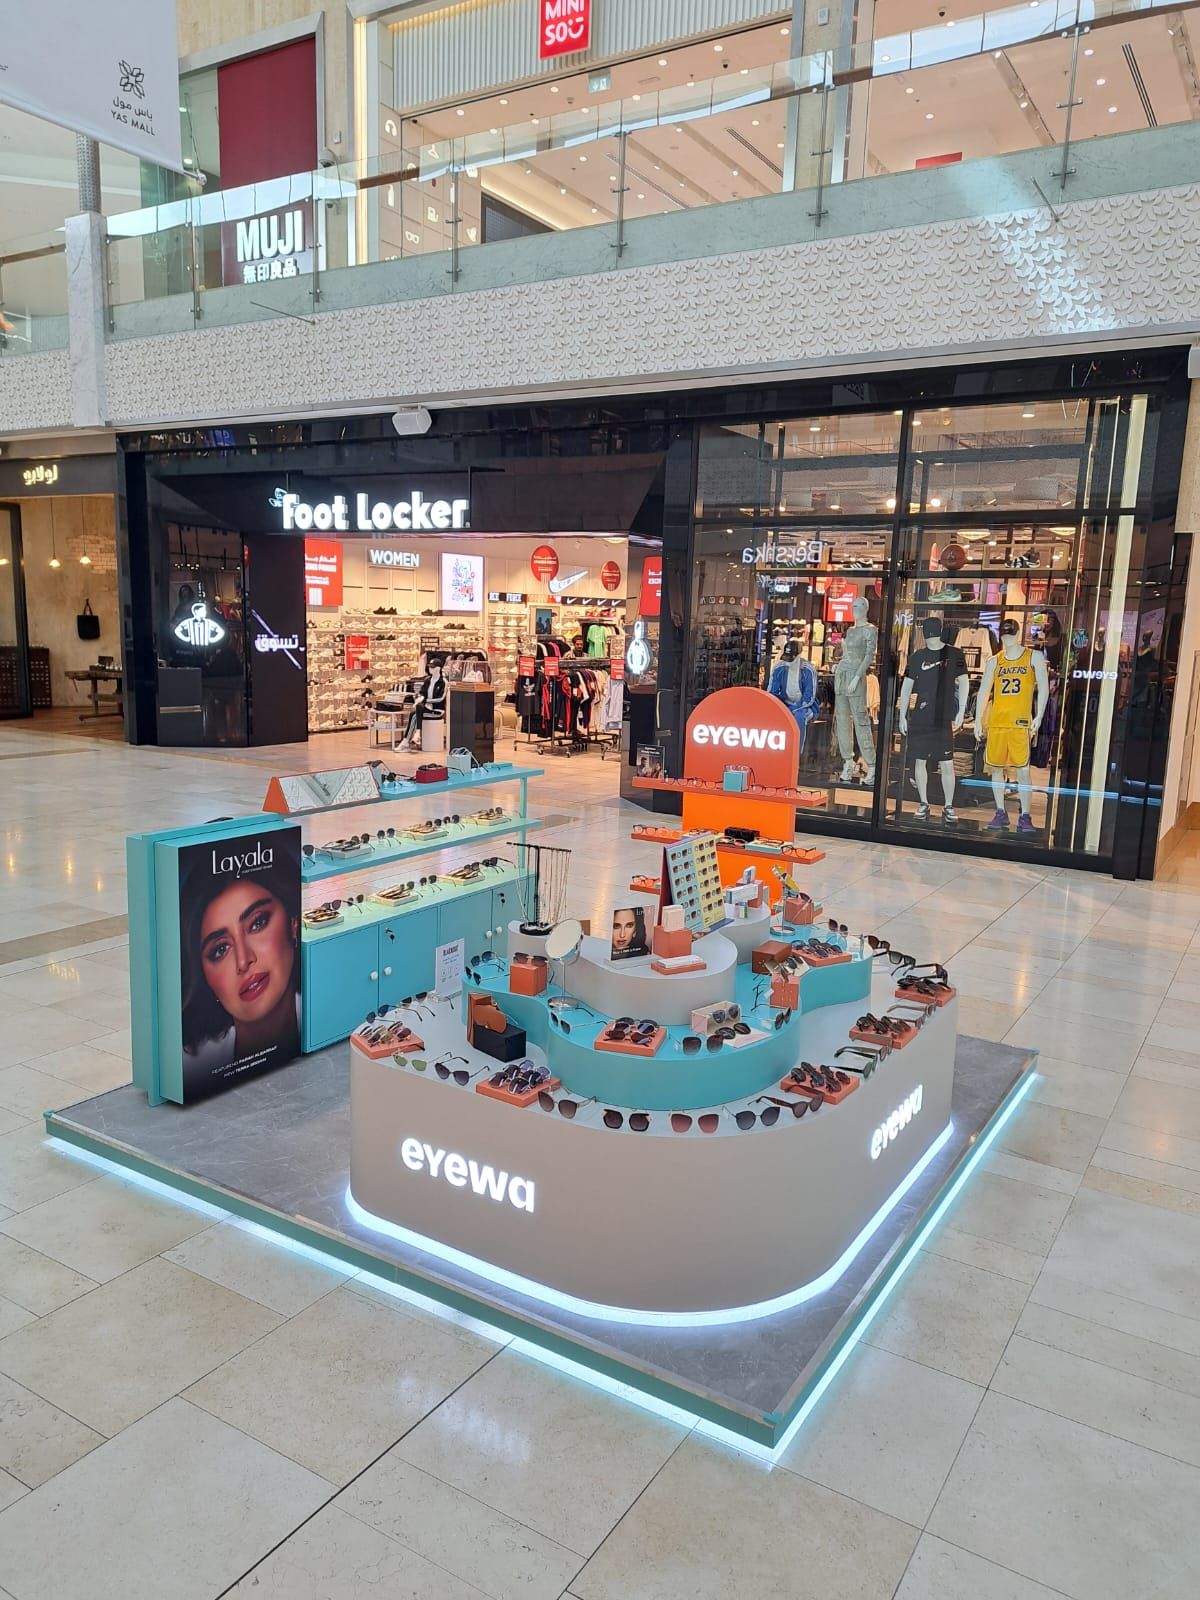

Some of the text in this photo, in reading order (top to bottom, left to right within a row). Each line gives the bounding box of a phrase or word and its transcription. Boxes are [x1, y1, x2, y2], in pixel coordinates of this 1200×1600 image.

[545, 0, 585, 20] MINI
[112, 96, 153, 122] ياس مول
[110, 110, 156, 136] YAS MALL
[236, 210, 304, 263] MUJI
[243, 257, 298, 284] 無印良品
[282, 490, 469, 530] Foot Locker
[370, 549, 420, 568] WOMEN
[997, 666, 1028, 677] LAKERS
[1000, 678, 1021, 694] 23
[692, 723, 786, 751] eyewa
[212, 841, 273, 879] Layala
[871, 1084, 923, 1160] eyewa
[401, 1137, 535, 1213] eyewa
